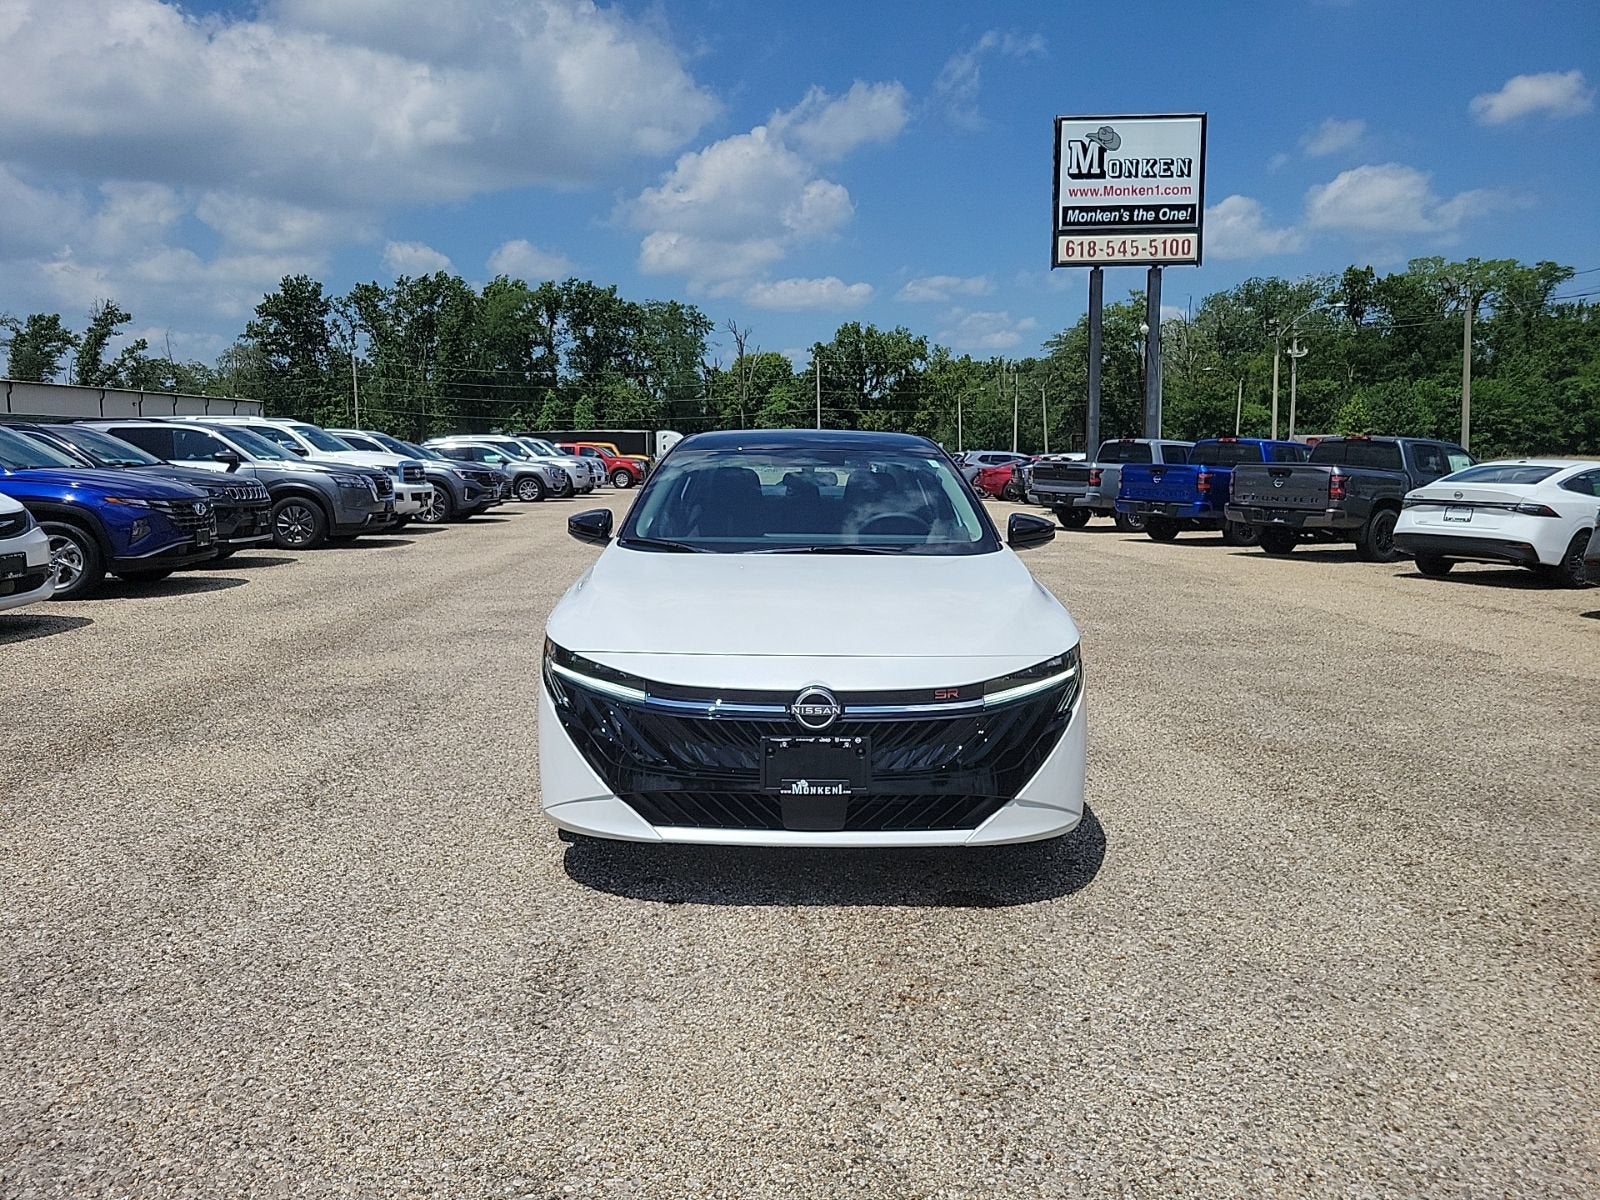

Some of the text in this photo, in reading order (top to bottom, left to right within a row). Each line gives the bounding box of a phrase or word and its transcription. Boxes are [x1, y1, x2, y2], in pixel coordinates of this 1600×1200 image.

[1068, 140, 1192, 179] MONKEN
[1069, 185, 1192, 197] www.Monken1.com
[1066, 207, 1192, 222] Monken's the One!
[1065, 238, 1192, 258] 618-545-5100
[934, 688, 960, 700] SR
[791, 705, 841, 715] NISSAN
